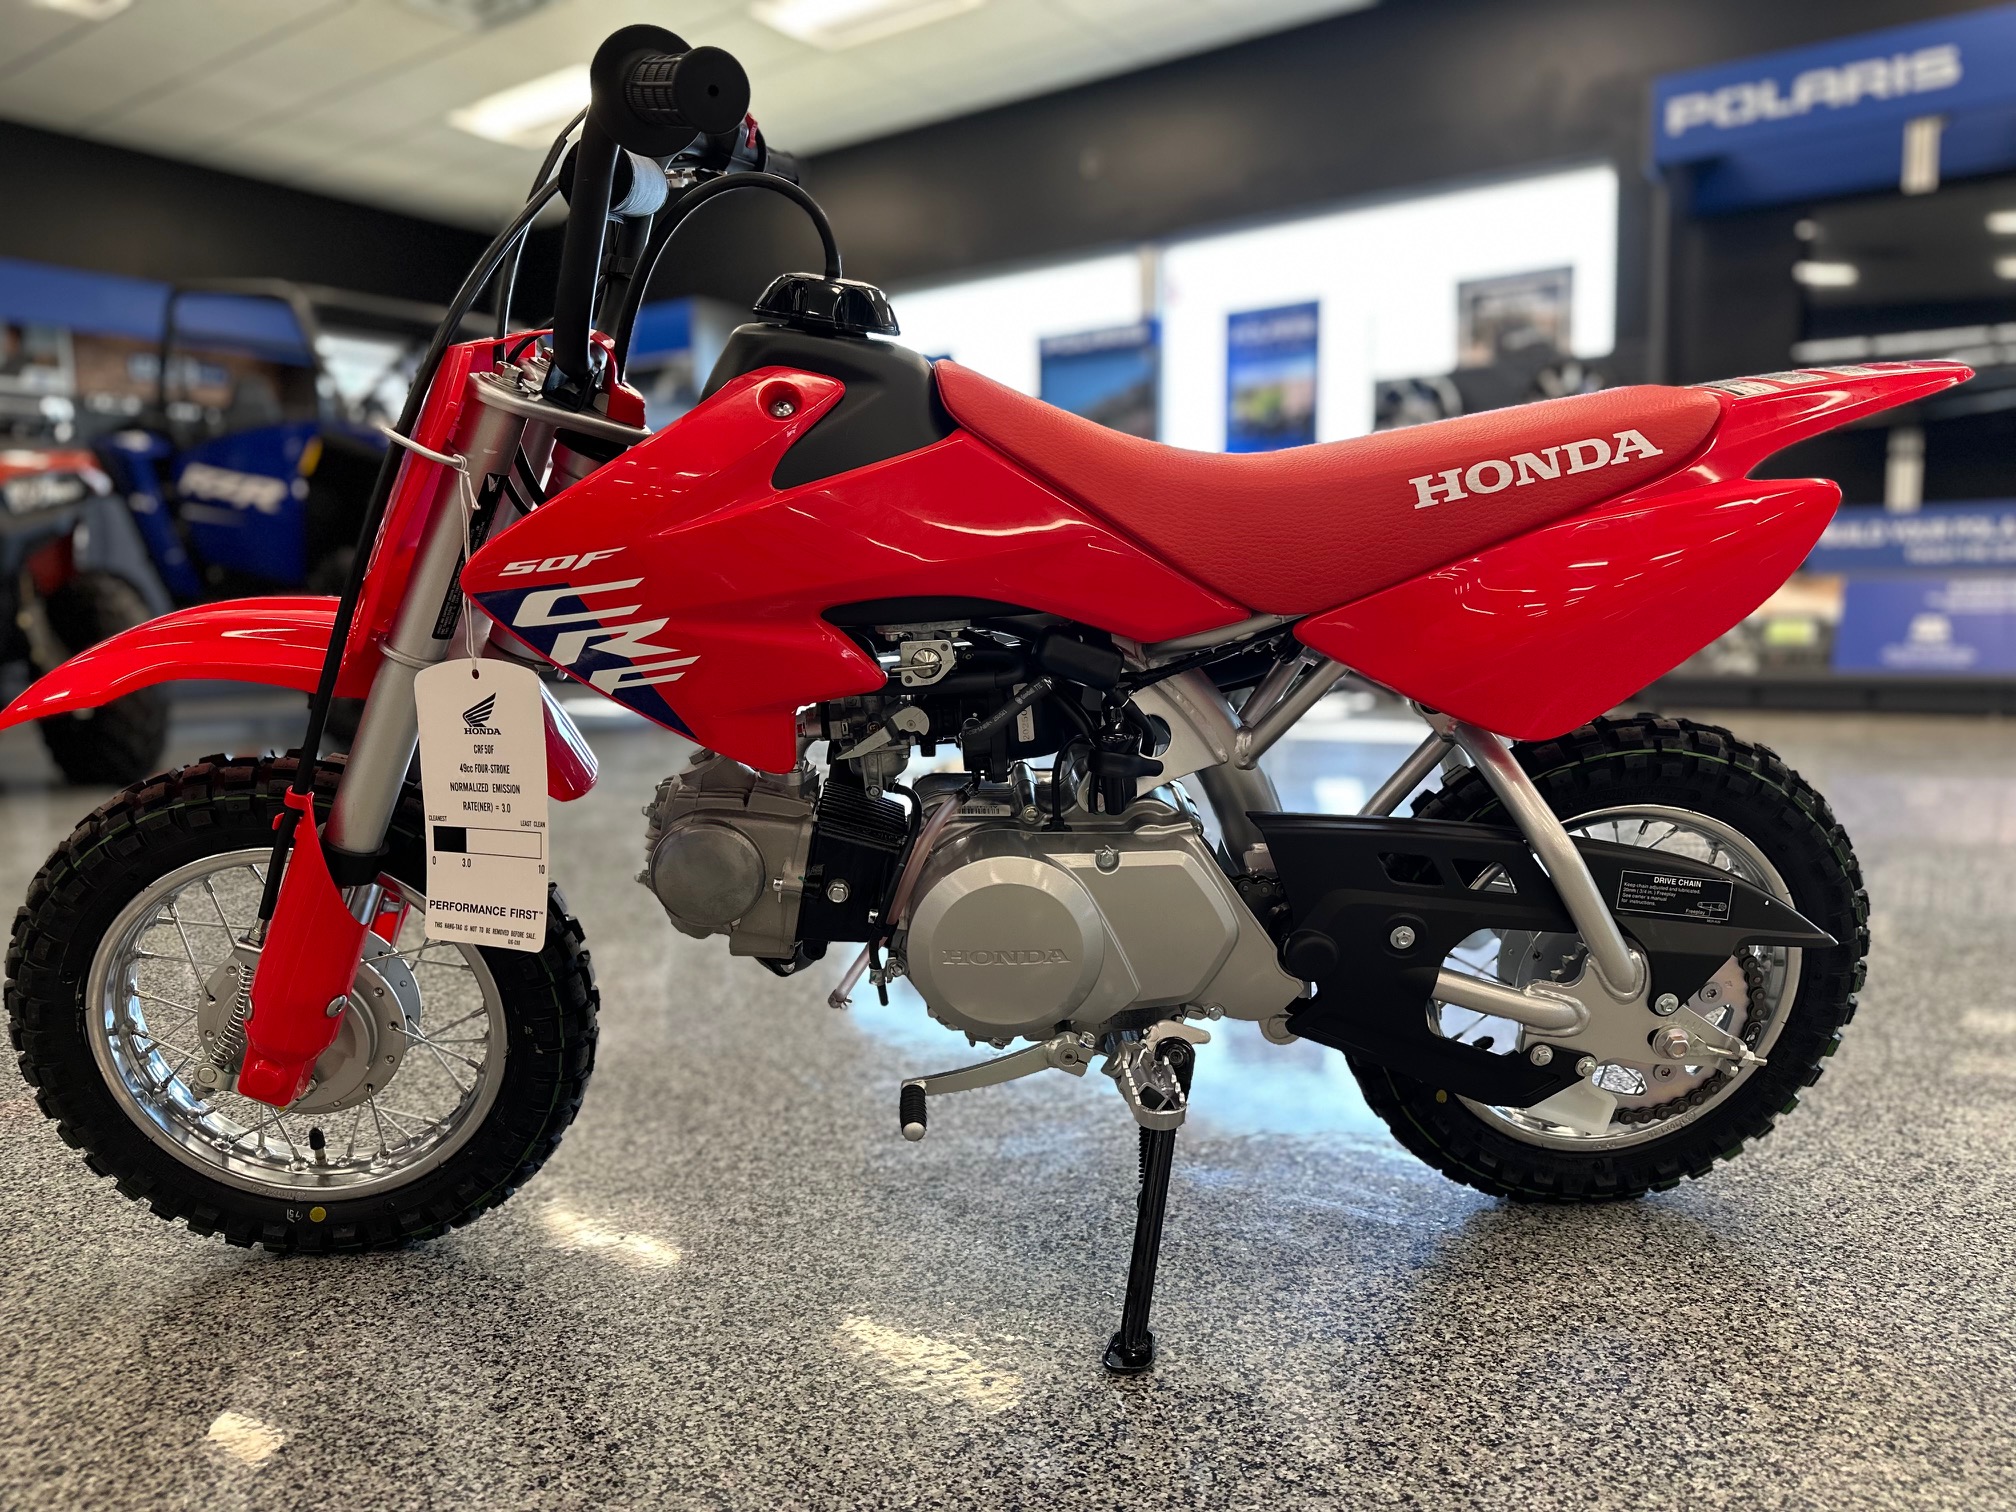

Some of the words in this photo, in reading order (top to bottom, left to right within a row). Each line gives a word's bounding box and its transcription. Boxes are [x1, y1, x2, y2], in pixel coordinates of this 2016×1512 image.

[1663, 44, 1963, 138] POLARIS
[1409, 429, 1664, 510] HONDA
[498, 546, 627, 577] 50F
[512, 577, 701, 696] CRF
[463, 728, 502, 736] HONDA
[460, 763, 474, 773] 49cc
[475, 764, 510, 774] FOUR-STROKE
[450, 782, 489, 792] NORMALIZED
[492, 783, 521, 794] EMISSION
[462, 801, 493, 813] RATE(NER)
[501, 803, 511, 813] 3.0
[432, 856, 437, 865] 0
[461, 858, 472, 868] 3.0
[538, 864, 546, 874] 10
[1654, 876, 1677, 885] DRIVE
[1678, 878, 1702, 888] CHAIN
[429, 900, 506, 917] PERFORMANCE
[444, 922, 463, 930] HANG-TAG
[492, 928, 510, 936] REMOVED
[511, 930, 524, 938] BEFORE
[942, 948, 1072, 966] HONDA
